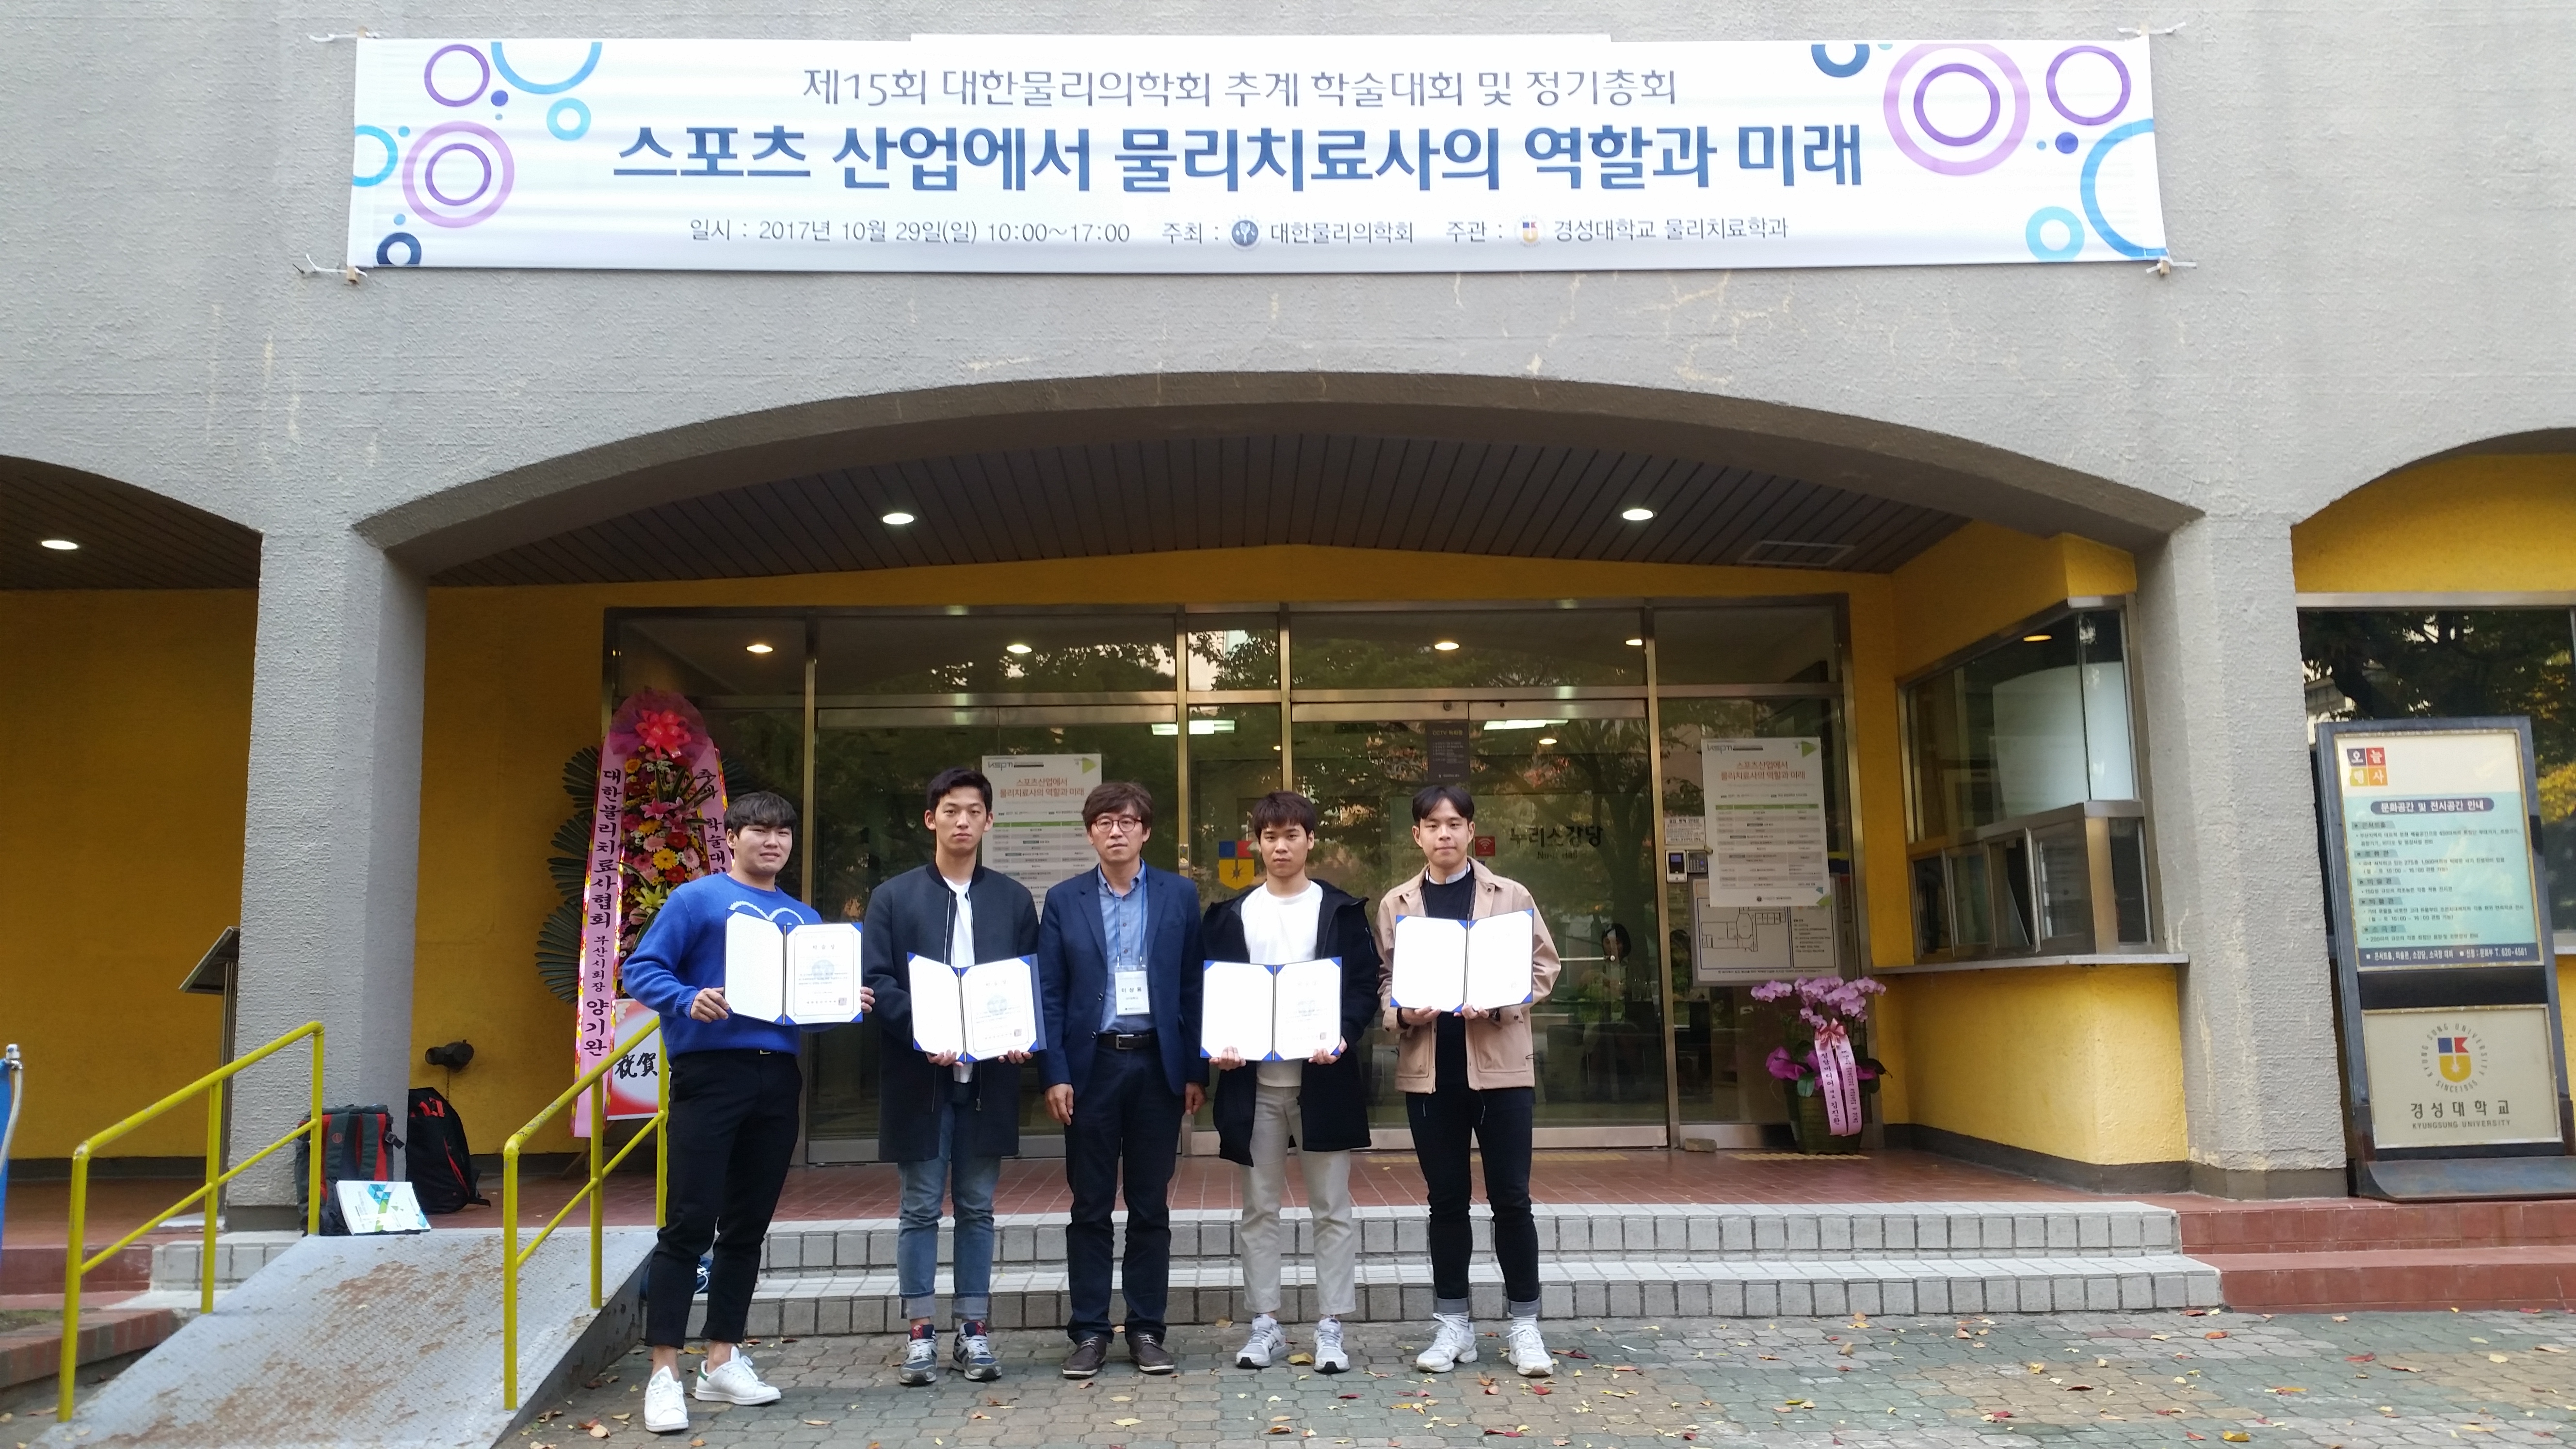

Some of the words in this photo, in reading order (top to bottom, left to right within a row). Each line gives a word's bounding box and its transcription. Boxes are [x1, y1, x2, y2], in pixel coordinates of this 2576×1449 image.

[803, 68, 926, 107] 제15회
[943, 69, 1210, 108] 대한물리의학회
[1224, 71, 1299, 108] 추계
[1310, 71, 1463, 108] 학술대회
[1478, 71, 1512, 107] 및
[1526, 68, 1675, 107] 정기총회
[613, 125, 811, 177] 스포츠
[832, 127, 1090, 192] 산업에서
[1114, 127, 1500, 193] 물리치료사의
[1524, 125, 1718, 190] 역할과
[1738, 124, 1862, 187] 미래
[690, 218, 730, 242] 일시
[758, 220, 831, 242] 2017년
[842, 220, 886, 243] 10월
[895, 219, 978, 243] 29일(일)
[1161, 222, 1203, 243] 주최
[1271, 221, 1414, 244] 대한물리의학회
[1446, 220, 1486, 243] 주관
[1555, 218, 1657, 243] 경성대학교
[1666, 217, 1787, 241] 물리치료학과
[1737, 761, 1788, 770] 스포츠산업에서
[1016, 778, 1068, 787] 스포츠산업에서
[1721, 771, 1765, 780] 물리치료사의
[999, 788, 1044, 798] 물리치료사의
[1046, 788, 1068, 797] 역할과
[1069, 788, 1084, 796] 미래
[2381, 801, 2415, 813] 문화공간
[589, 768, 622, 929] 대한물리치료사협회
[591, 935, 610, 993] 부산시회장
[583, 998, 610, 1057] 양기완
[2411, 1100, 2510, 1119] 경성대학교
[2412, 1121, 2459, 1129] KYUNGSUNG
[2462, 1120, 2511, 1128] UNIVERSITY
